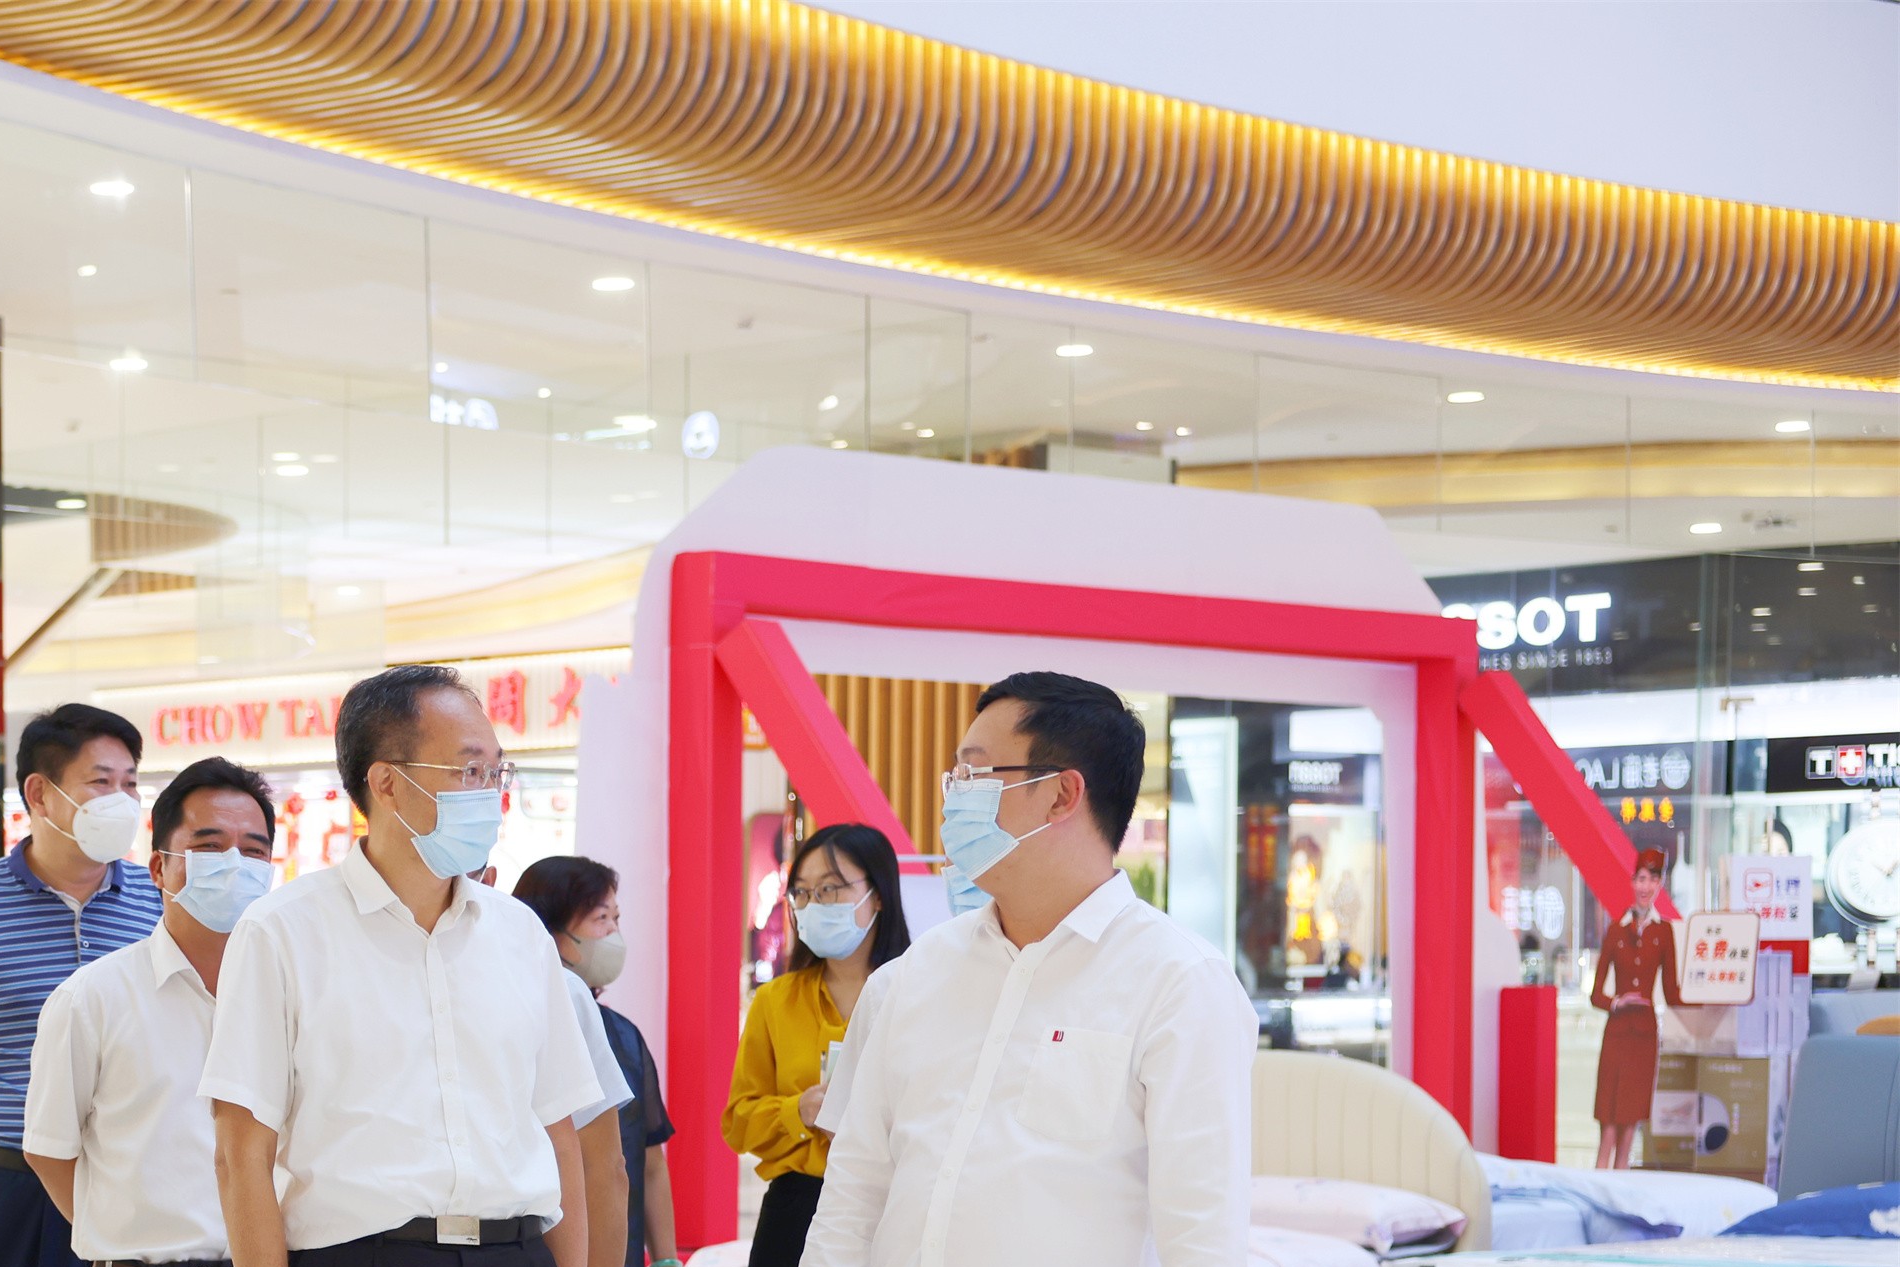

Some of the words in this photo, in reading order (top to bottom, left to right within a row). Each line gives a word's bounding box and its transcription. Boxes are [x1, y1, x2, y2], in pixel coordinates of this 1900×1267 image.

[1516, 649, 1569, 671] SINCE
[487, 667, 619, 735] 周大
[151, 700, 267, 747] CHOW
[1867, 743, 1900, 768] TI
